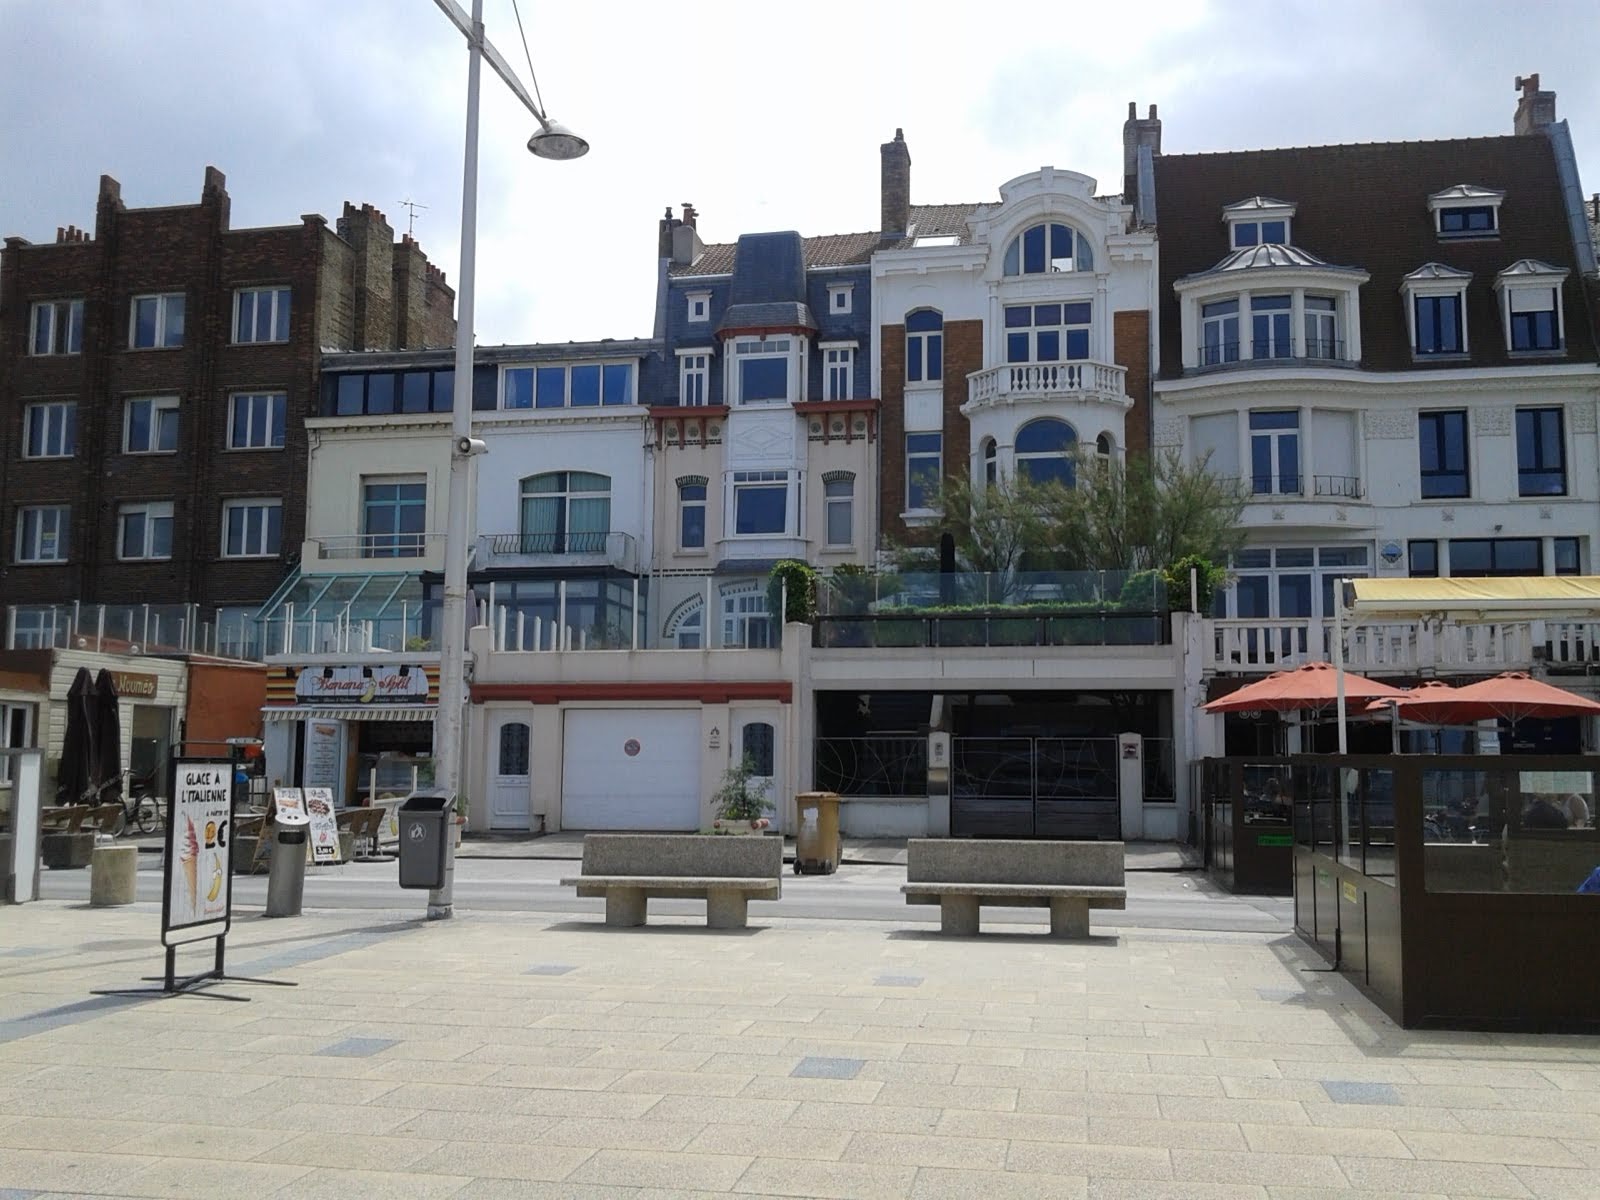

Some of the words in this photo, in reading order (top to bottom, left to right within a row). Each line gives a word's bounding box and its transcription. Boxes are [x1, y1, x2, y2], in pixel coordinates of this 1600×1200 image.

[311, 675, 364, 691] Banana
[379, 674, 412, 693] Split
[186, 772, 211, 786] GLACE
[181, 788, 227, 804] L'ITALIENNE
